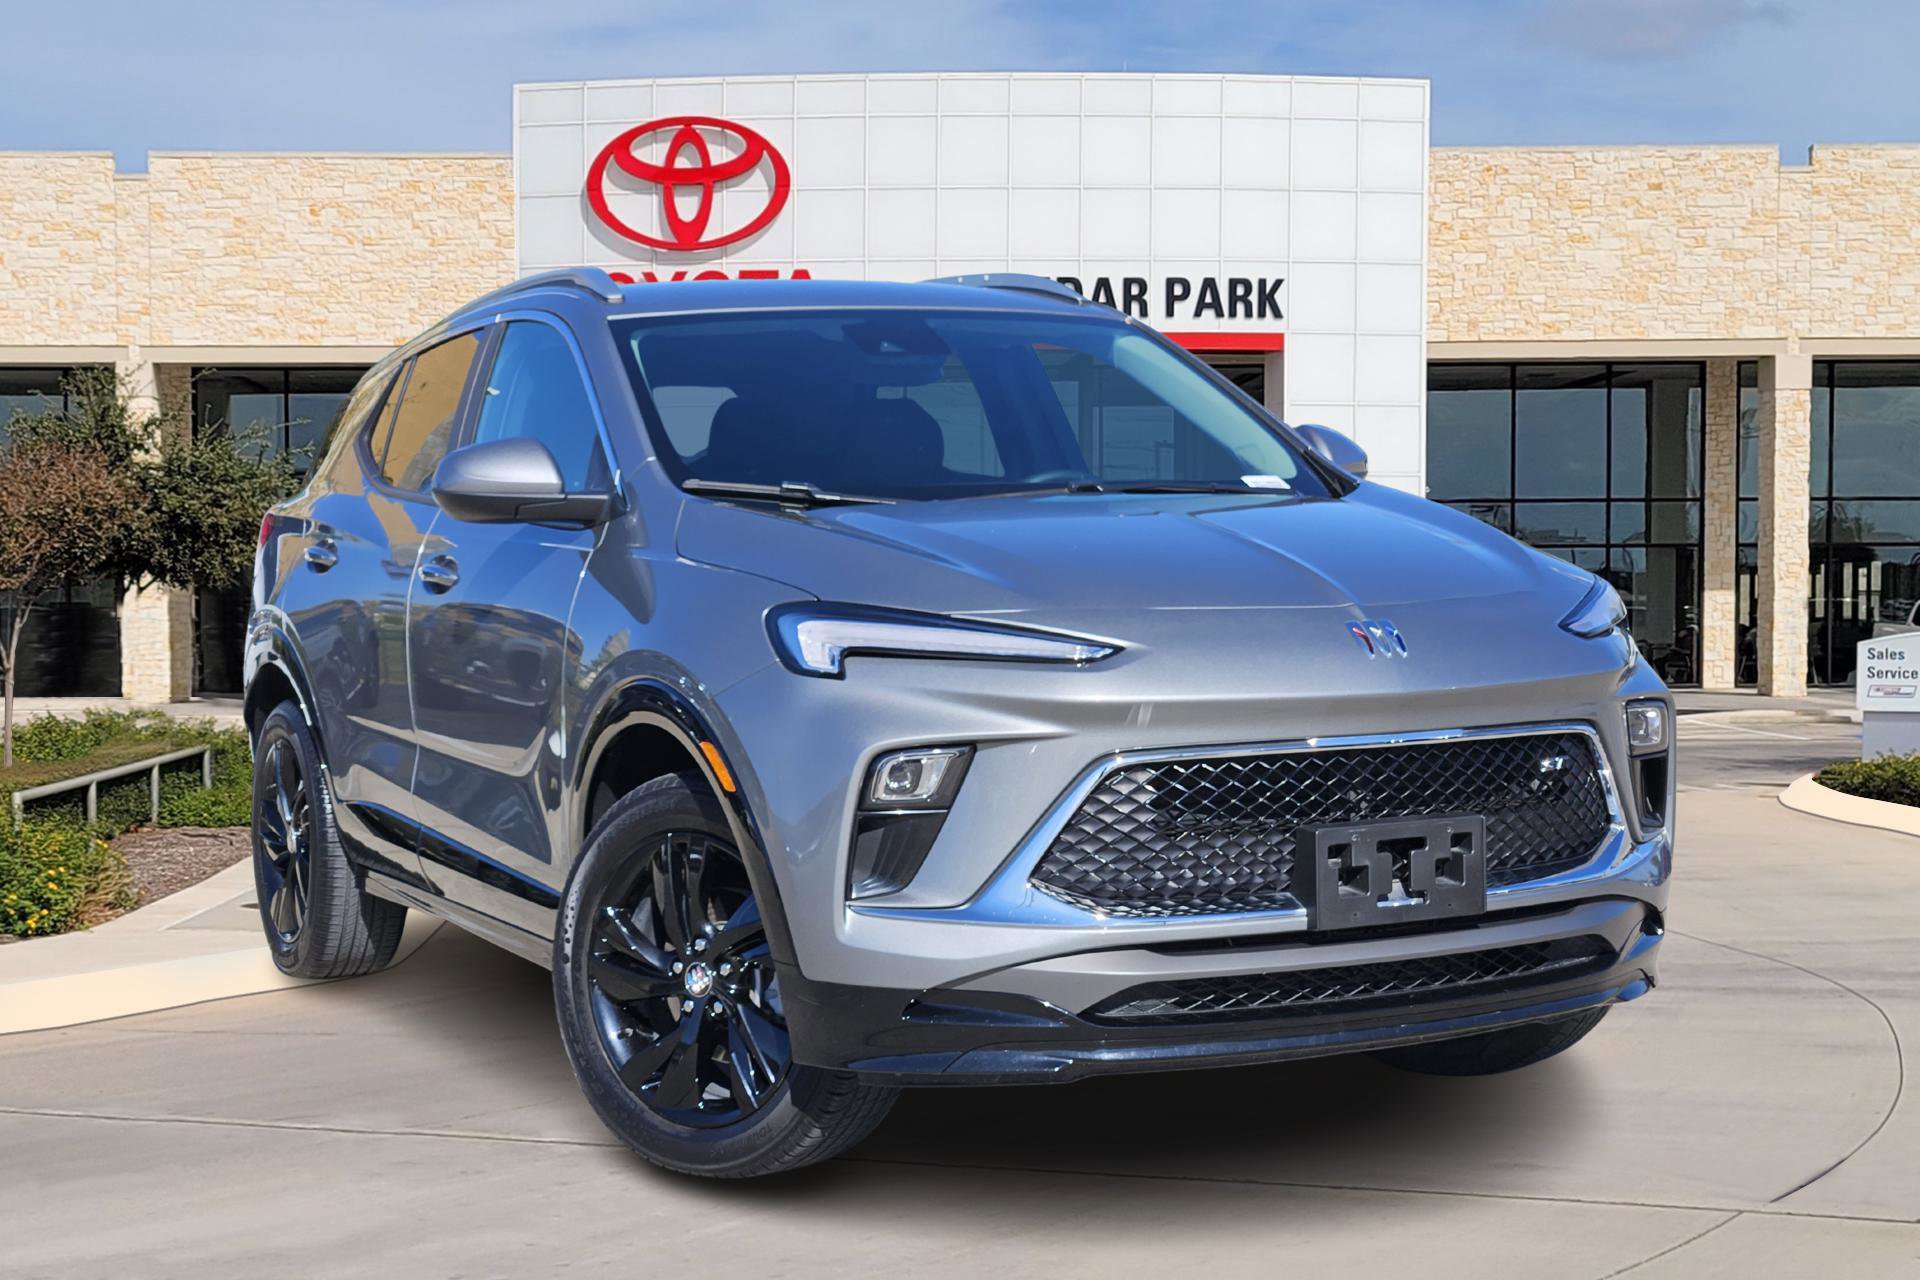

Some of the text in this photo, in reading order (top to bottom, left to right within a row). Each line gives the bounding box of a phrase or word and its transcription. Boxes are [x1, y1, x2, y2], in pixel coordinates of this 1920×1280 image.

[1165, 277, 1285, 319] PARK
[1867, 647, 1905, 660] Sales
[1867, 666, 1919, 679] Service
